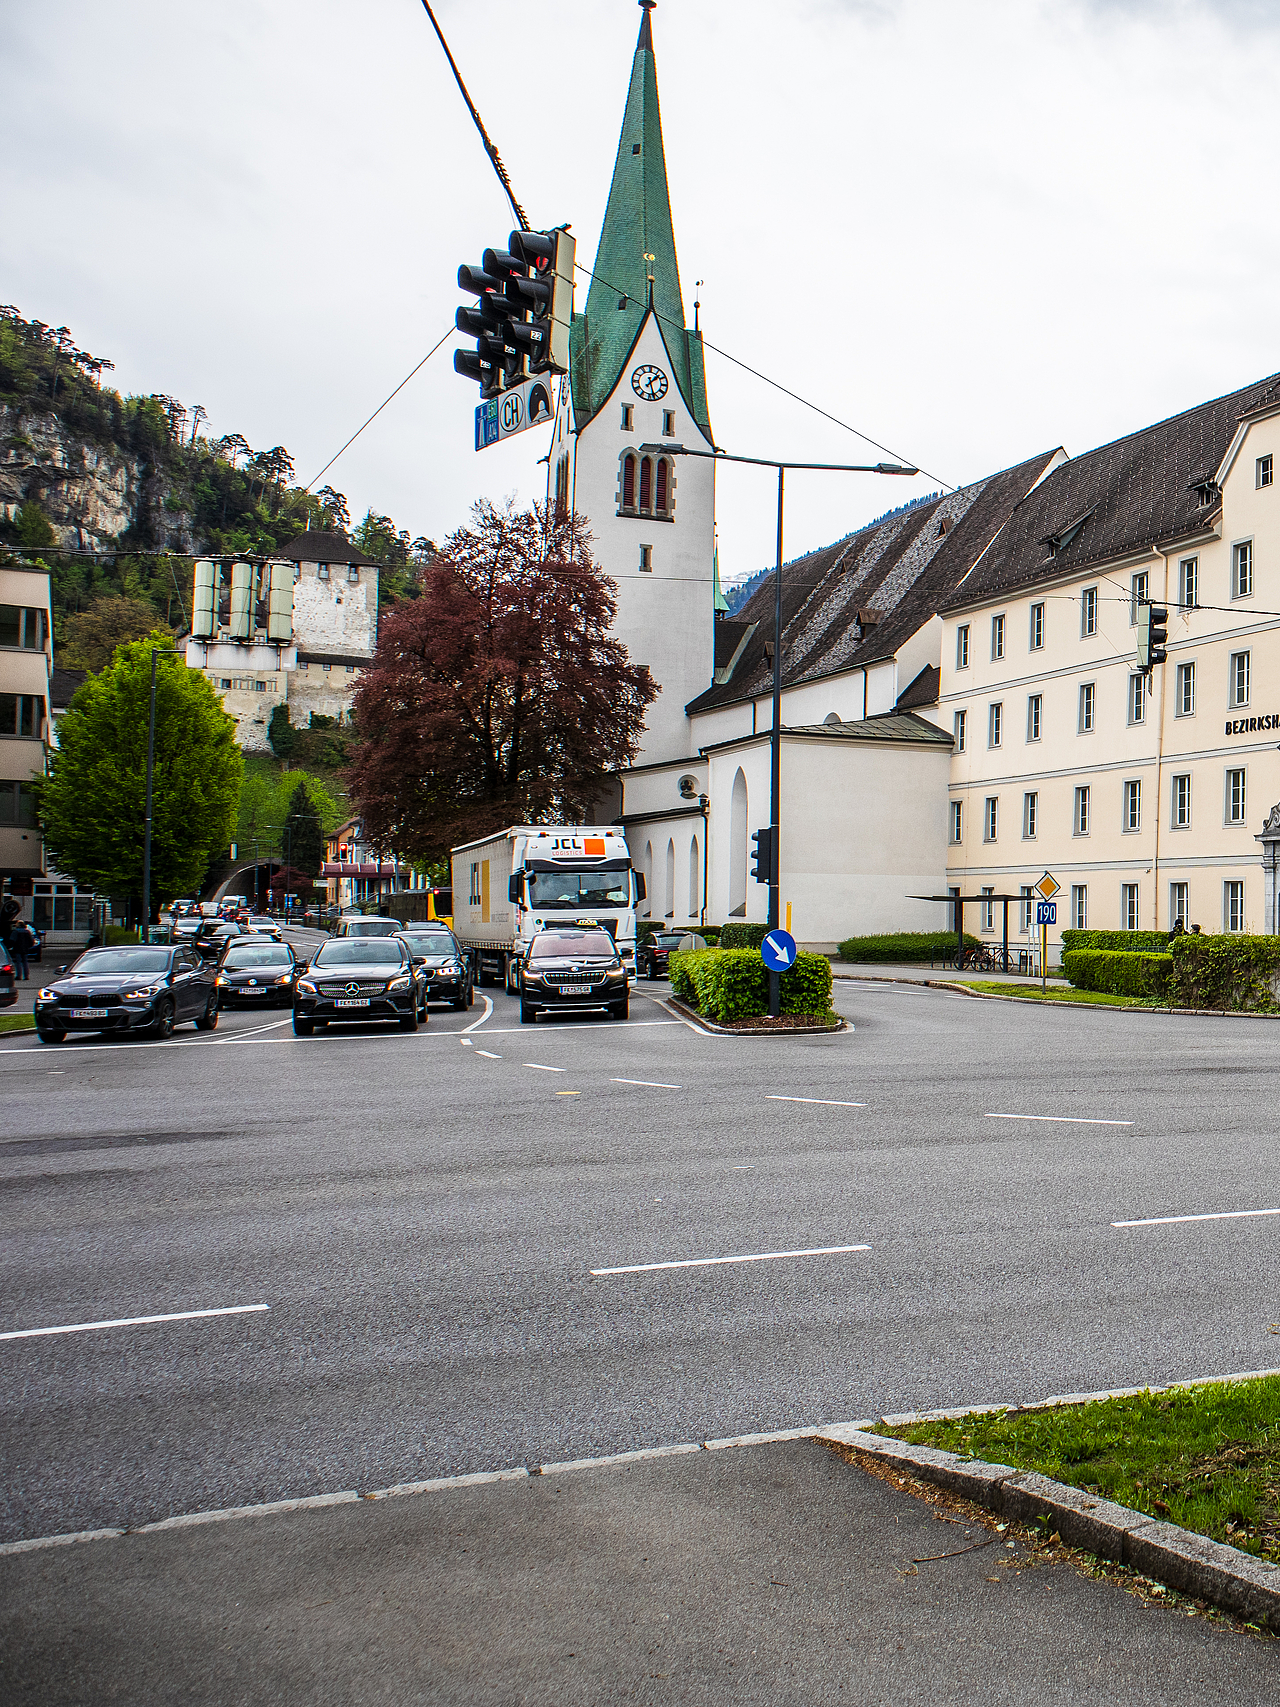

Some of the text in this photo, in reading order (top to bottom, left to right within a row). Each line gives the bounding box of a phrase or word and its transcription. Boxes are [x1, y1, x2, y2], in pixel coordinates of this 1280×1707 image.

[504, 397, 519, 427] CH
[551, 839, 582, 850] JCL
[1038, 905, 1056, 922] 190
